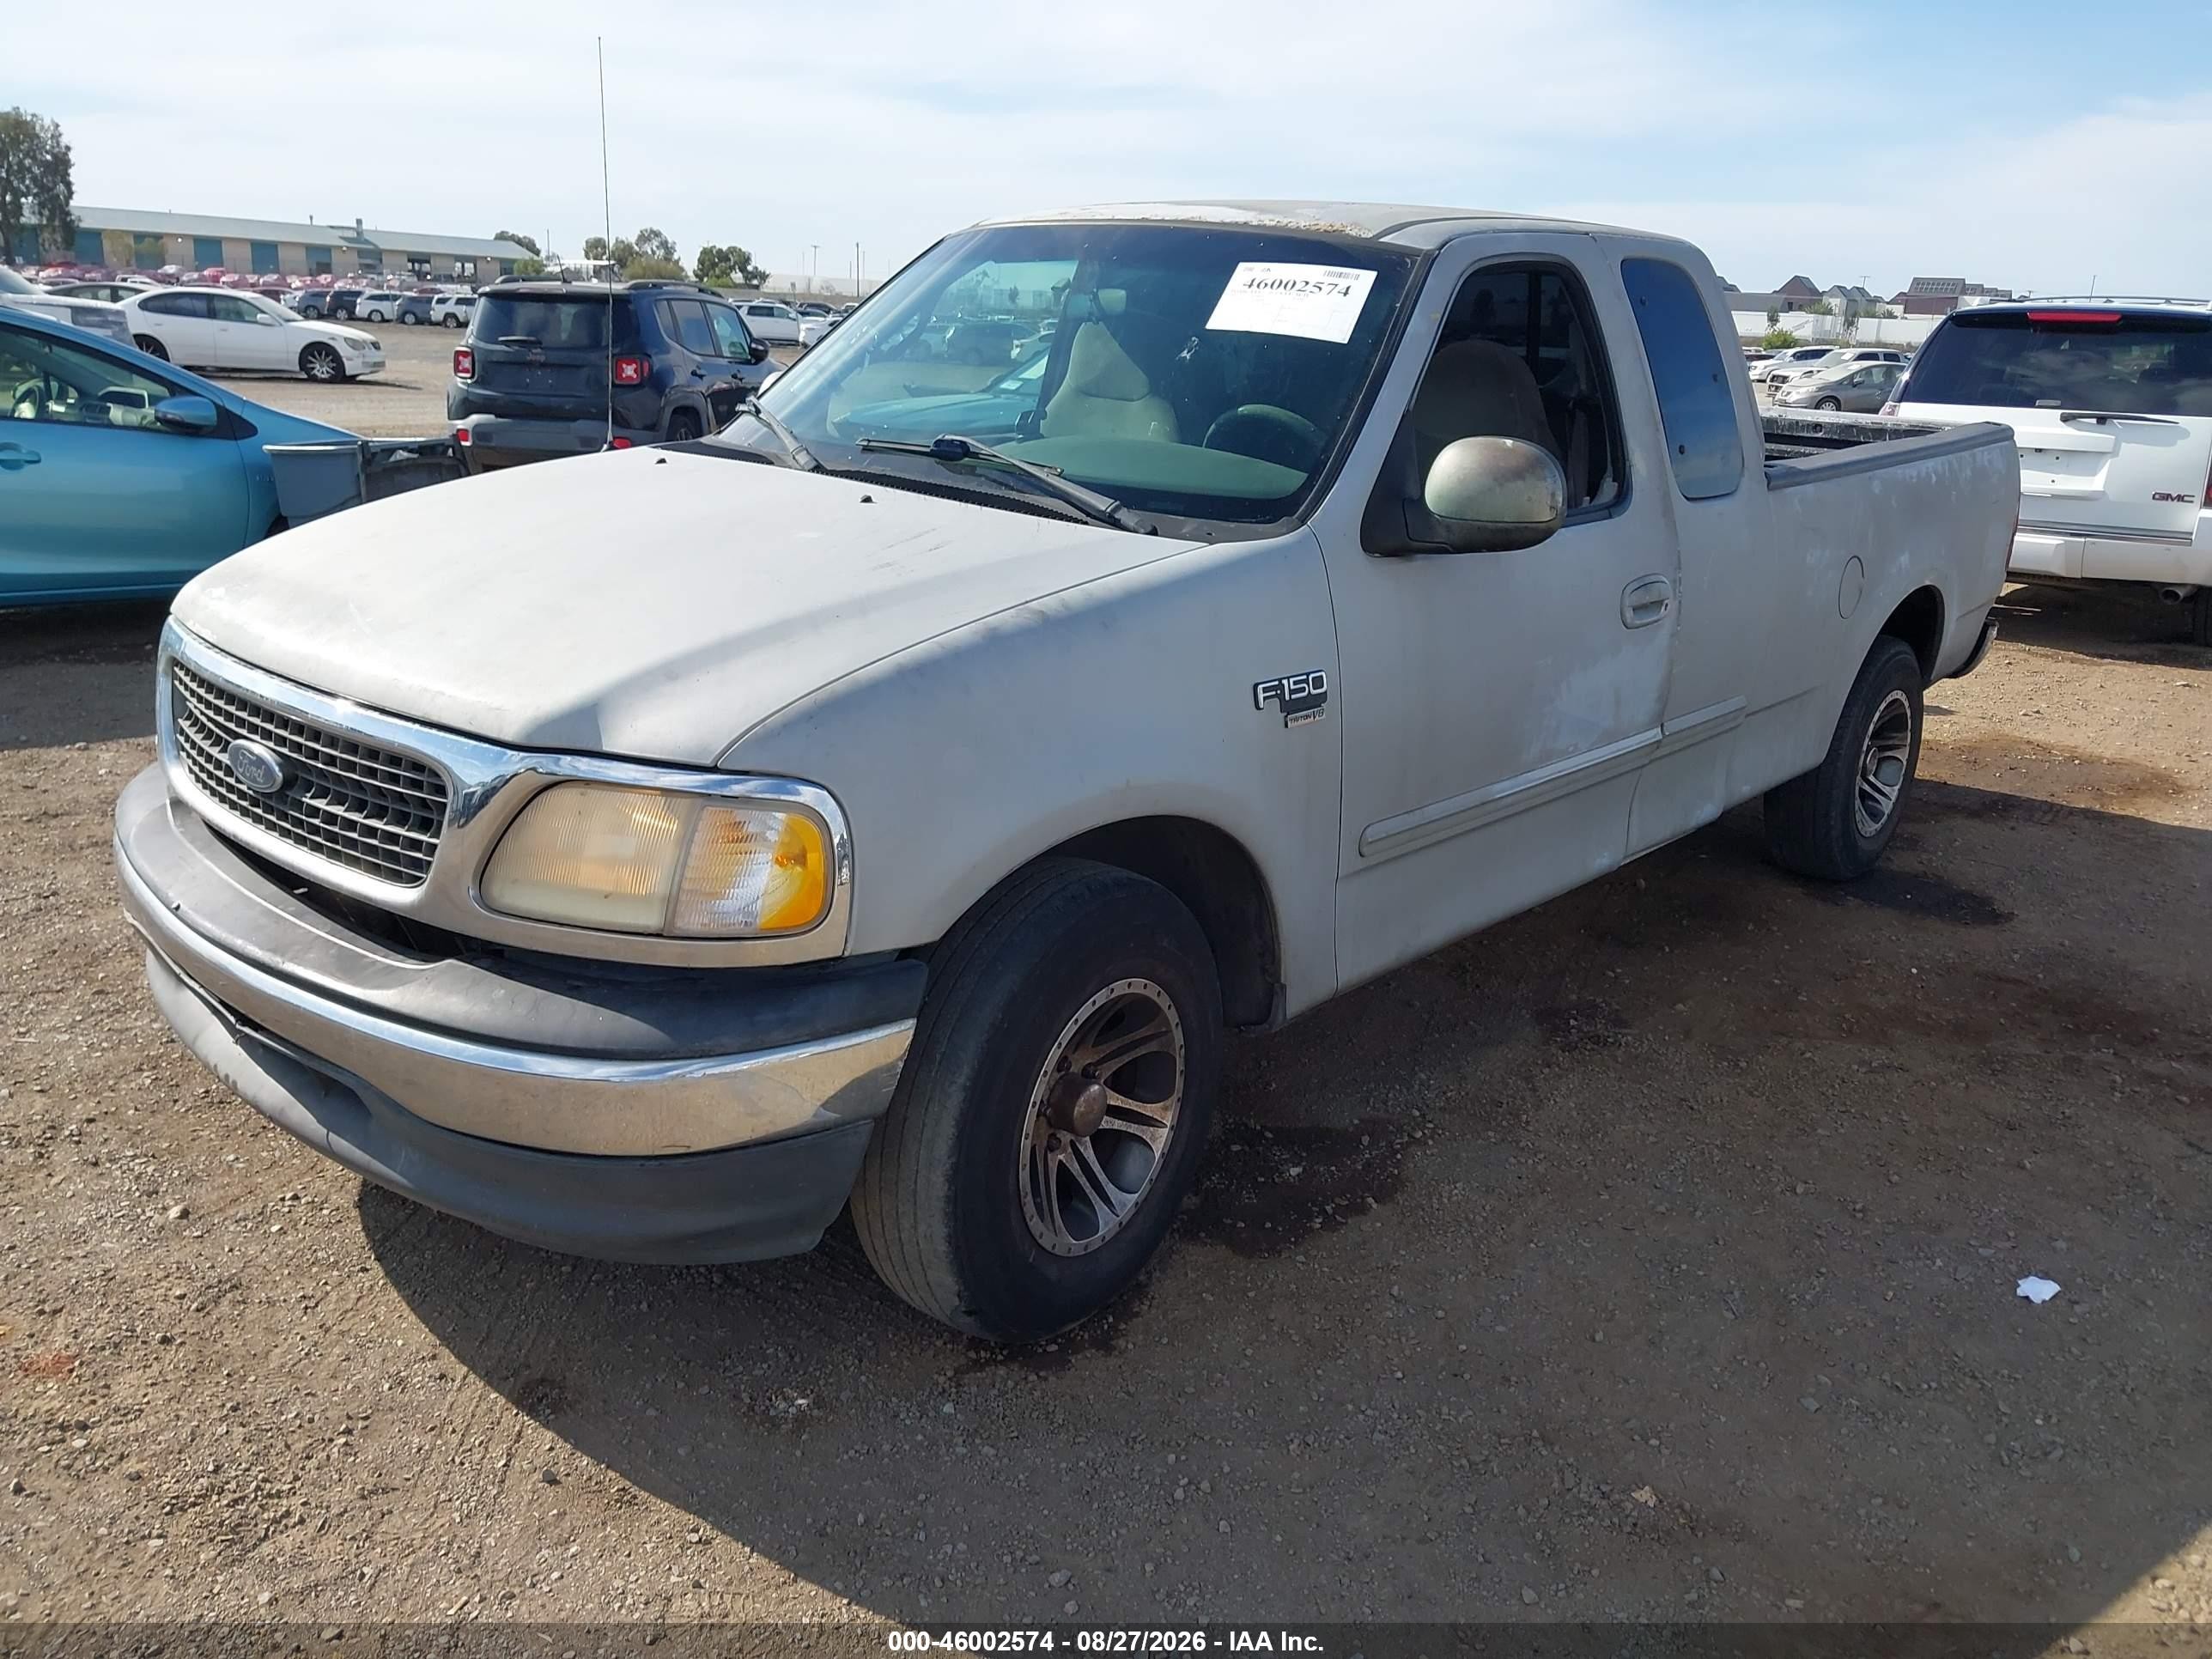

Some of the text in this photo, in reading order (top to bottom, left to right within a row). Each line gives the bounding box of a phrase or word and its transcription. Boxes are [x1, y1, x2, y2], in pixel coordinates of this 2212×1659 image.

[1242, 276, 1352, 297] 46002574
[2152, 492, 2196, 503] GMC
[238, 749, 265, 783] Ford
